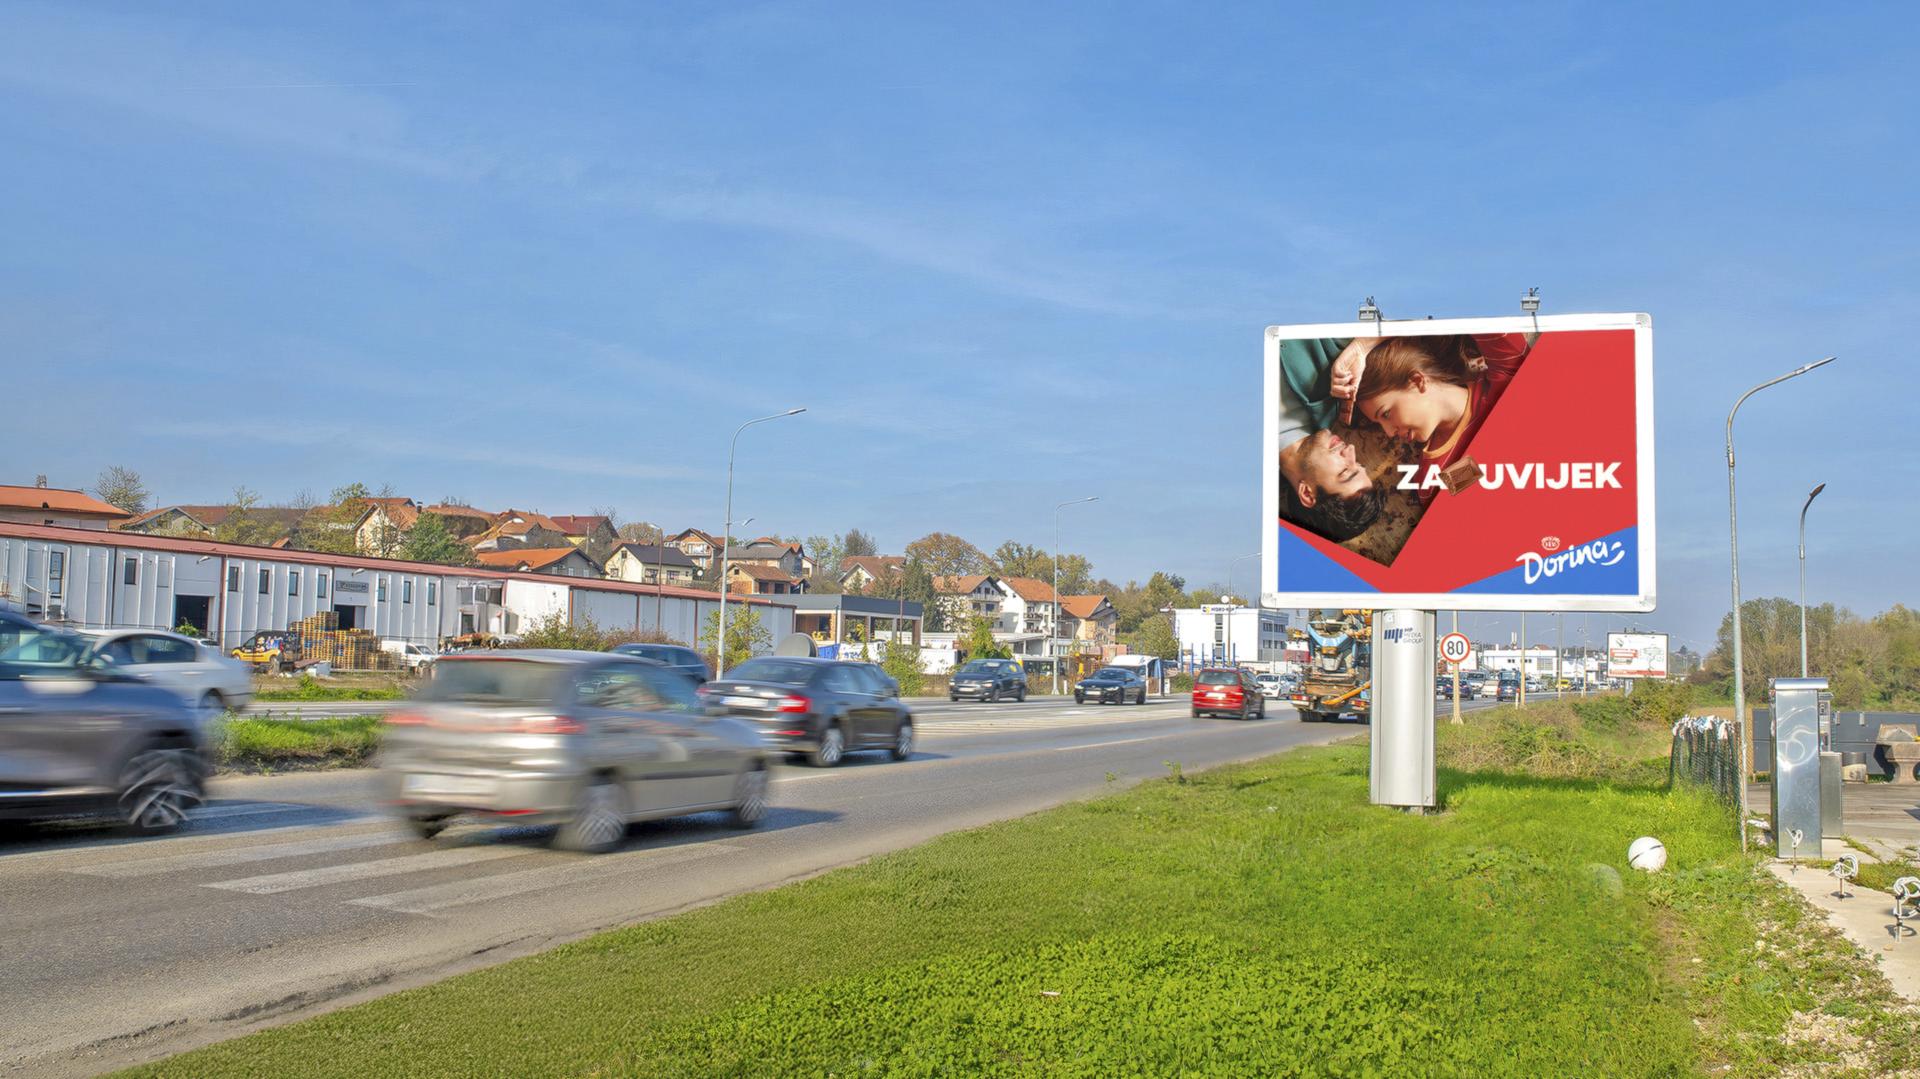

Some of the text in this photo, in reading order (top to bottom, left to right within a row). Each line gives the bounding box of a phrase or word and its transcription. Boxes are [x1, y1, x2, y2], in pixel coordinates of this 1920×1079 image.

[1396, 462, 1623, 490] ZA UVIJEK
[1515, 540, 1609, 585] Dorina
[1447, 640, 1464, 656] 80
